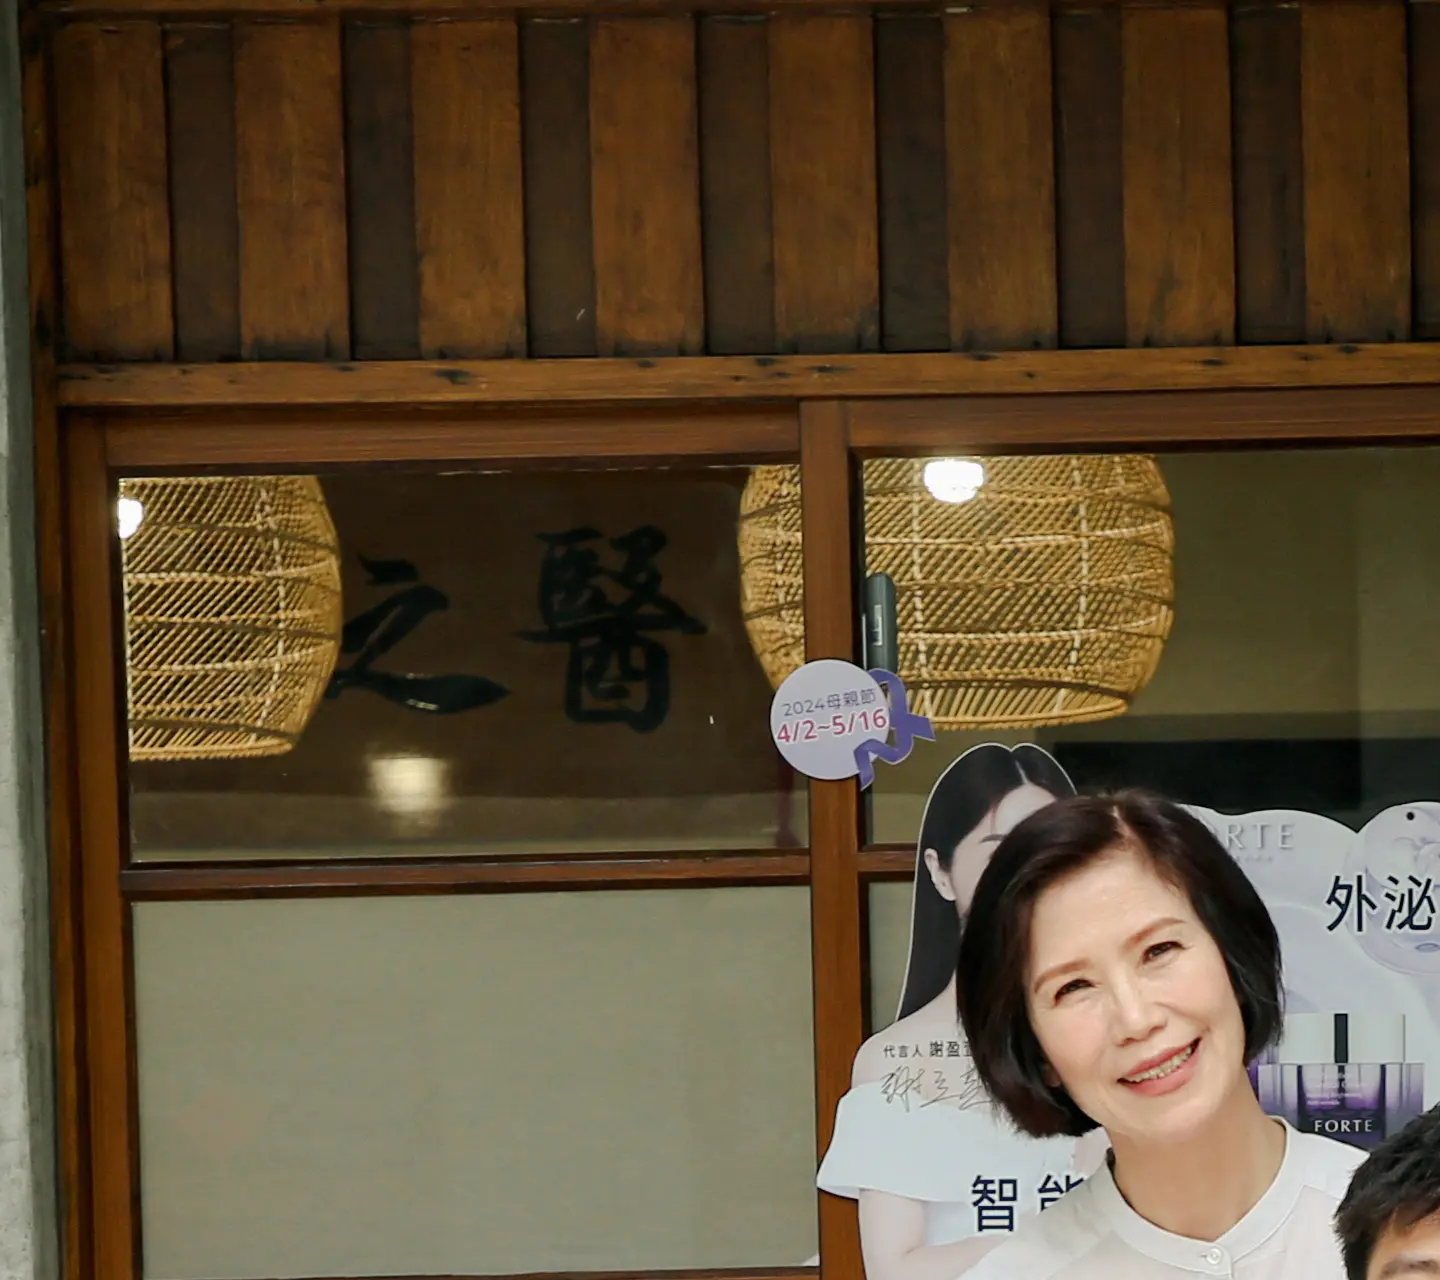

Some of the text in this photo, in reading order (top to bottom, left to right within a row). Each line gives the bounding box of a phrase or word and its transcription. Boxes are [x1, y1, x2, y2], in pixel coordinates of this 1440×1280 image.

[781, 687, 877, 717] 2024母親節
[777, 705, 887, 744] 4/2~5/16
[1224, 823, 1295, 850] RTE
[883, 1044, 924, 1058] 代言人
[1314, 1119, 1373, 1132] FORTE
